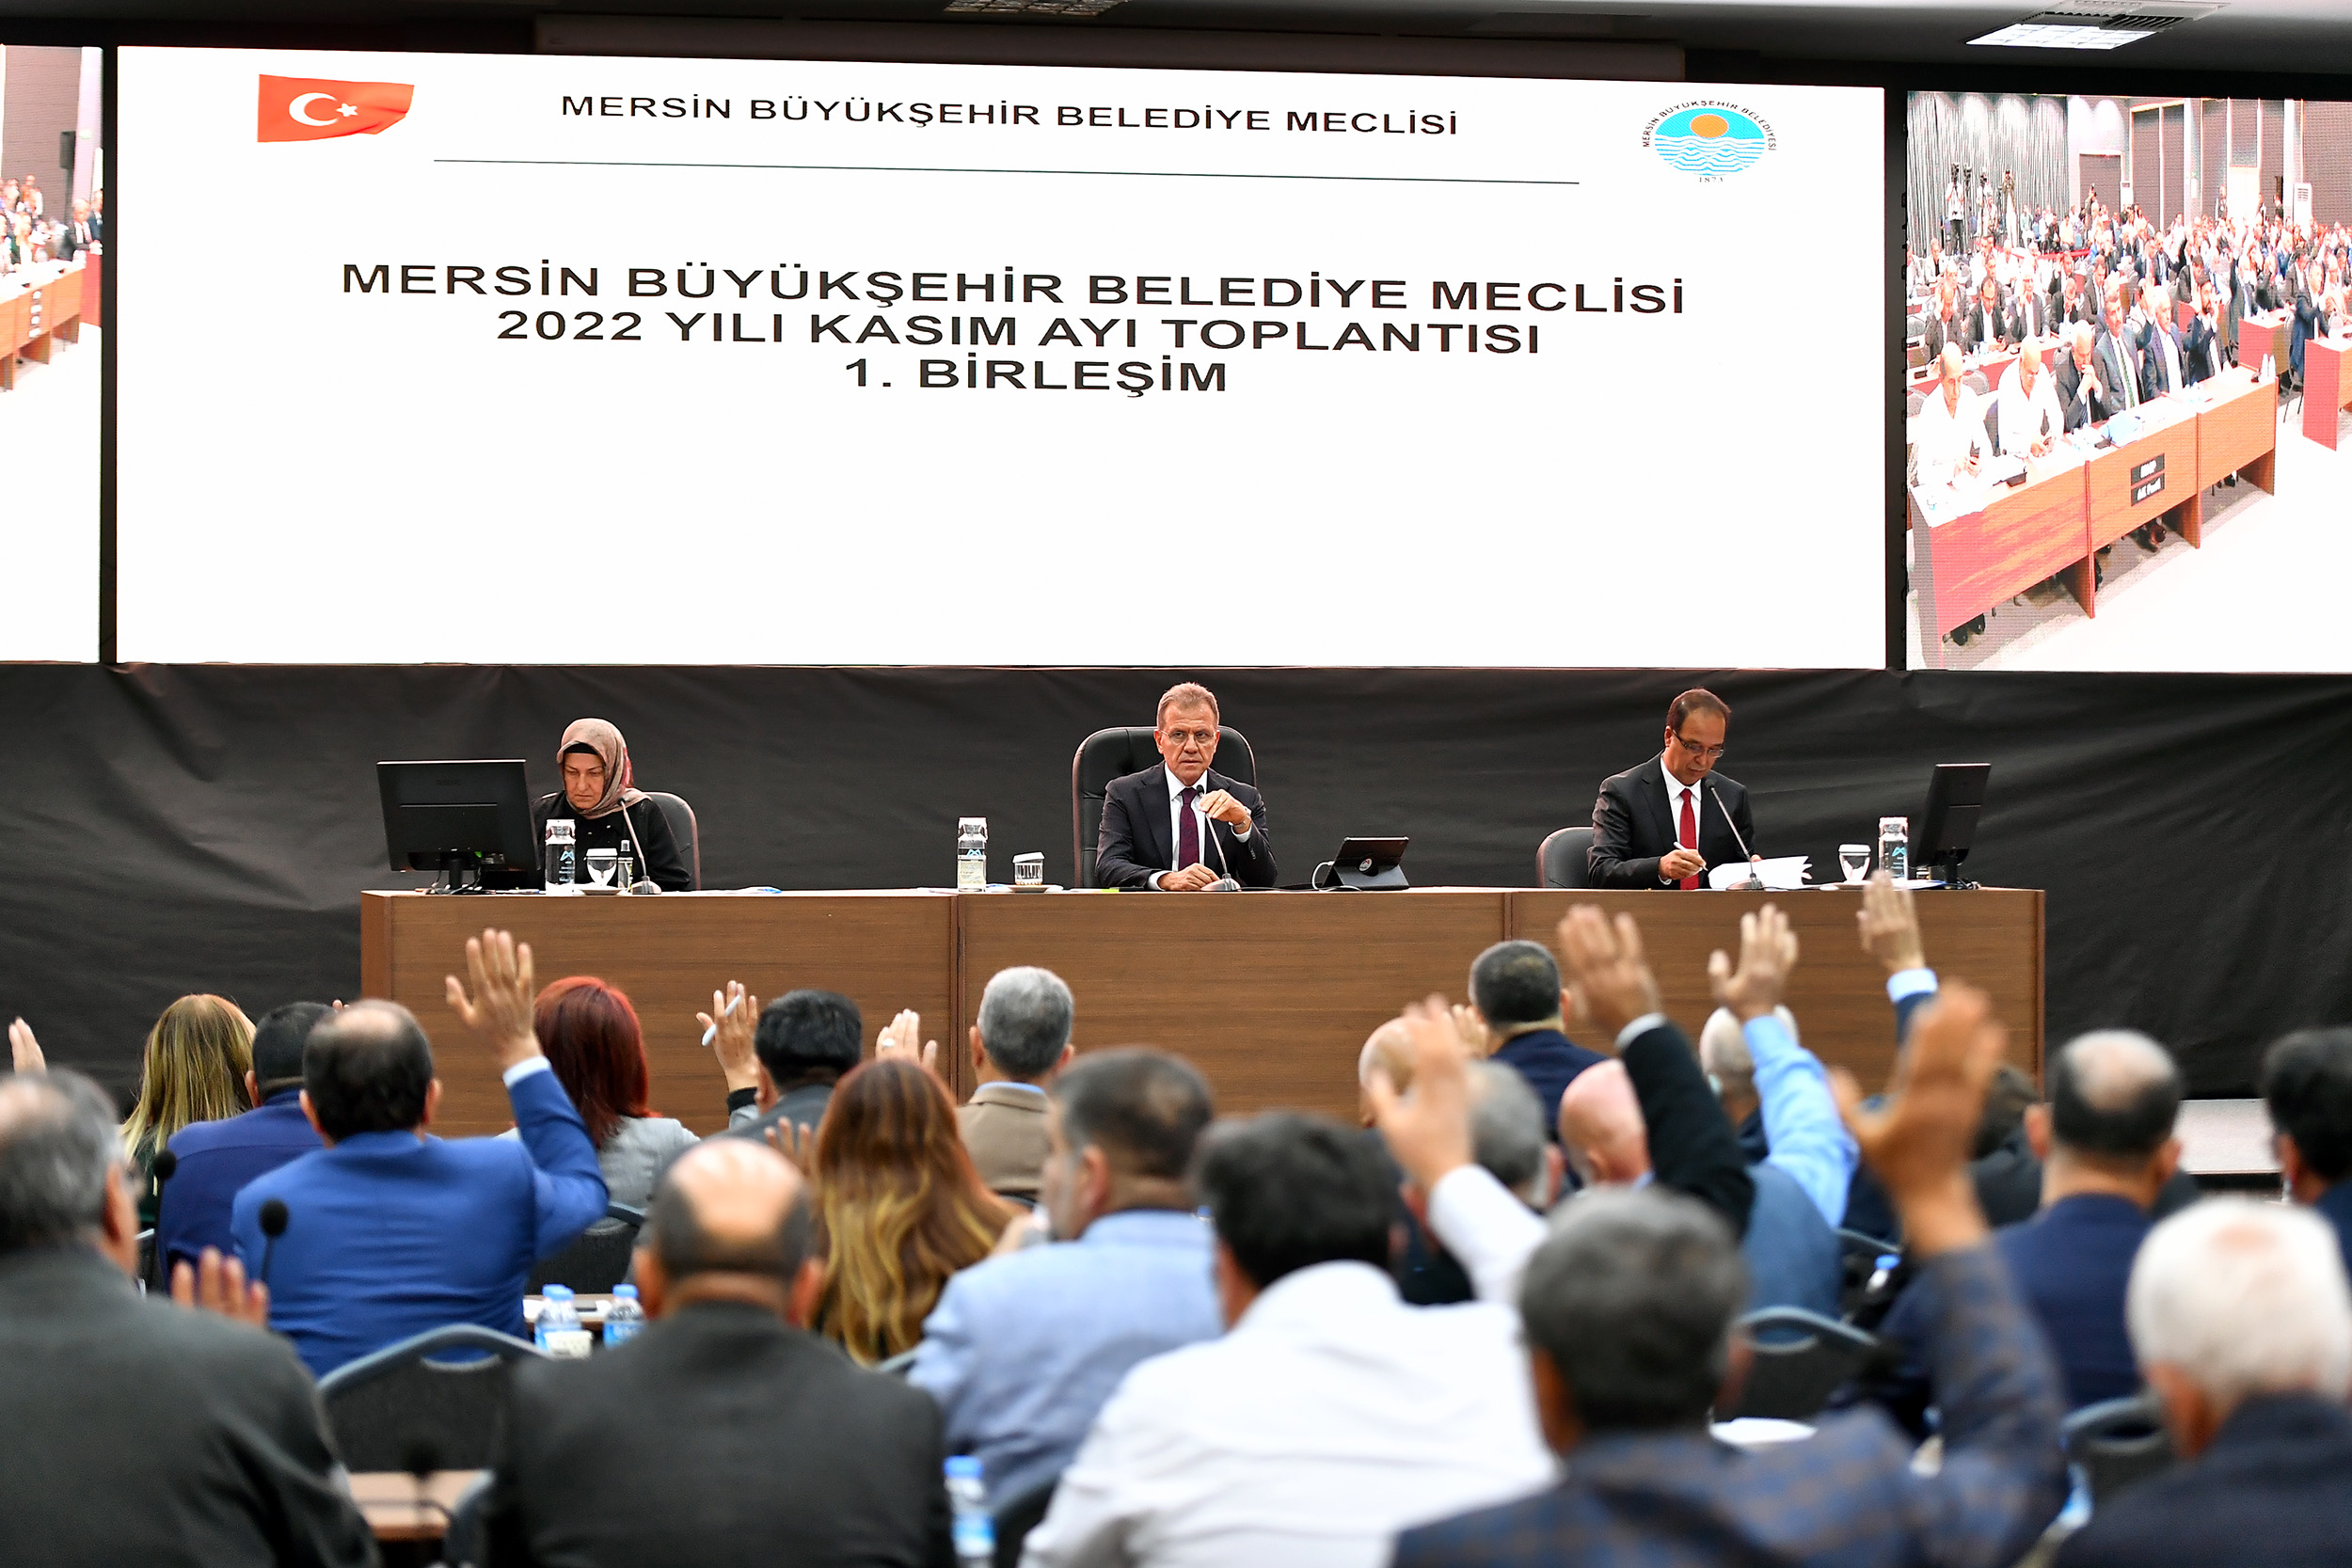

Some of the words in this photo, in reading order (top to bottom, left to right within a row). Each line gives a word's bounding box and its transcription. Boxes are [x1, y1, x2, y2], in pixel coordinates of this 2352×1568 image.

[563, 94, 730, 119] MERSİN
[751, 96, 1041, 128] BÜYÜKŞEHİR
[1057, 105, 1270, 131] BELEDİYE
[1287, 110, 1456, 135] MECLİSİ
[343, 260, 598, 296] MERSİN
[628, 262, 1064, 309] BÜYÜKŞEHİR
[1089, 272, 1407, 309] BELEDİYE
[1432, 277, 1683, 314] MECLİSİ
[497, 309, 642, 341] 2022
[664, 311, 783, 343] YILI
[811, 314, 1016, 346] KASIM
[1038, 317, 1136, 348] AYI
[1161, 319, 1538, 355] TOPLANTISI
[846, 357, 892, 388] 1.
[919, 352, 1226, 398] BİRLEŞİM
